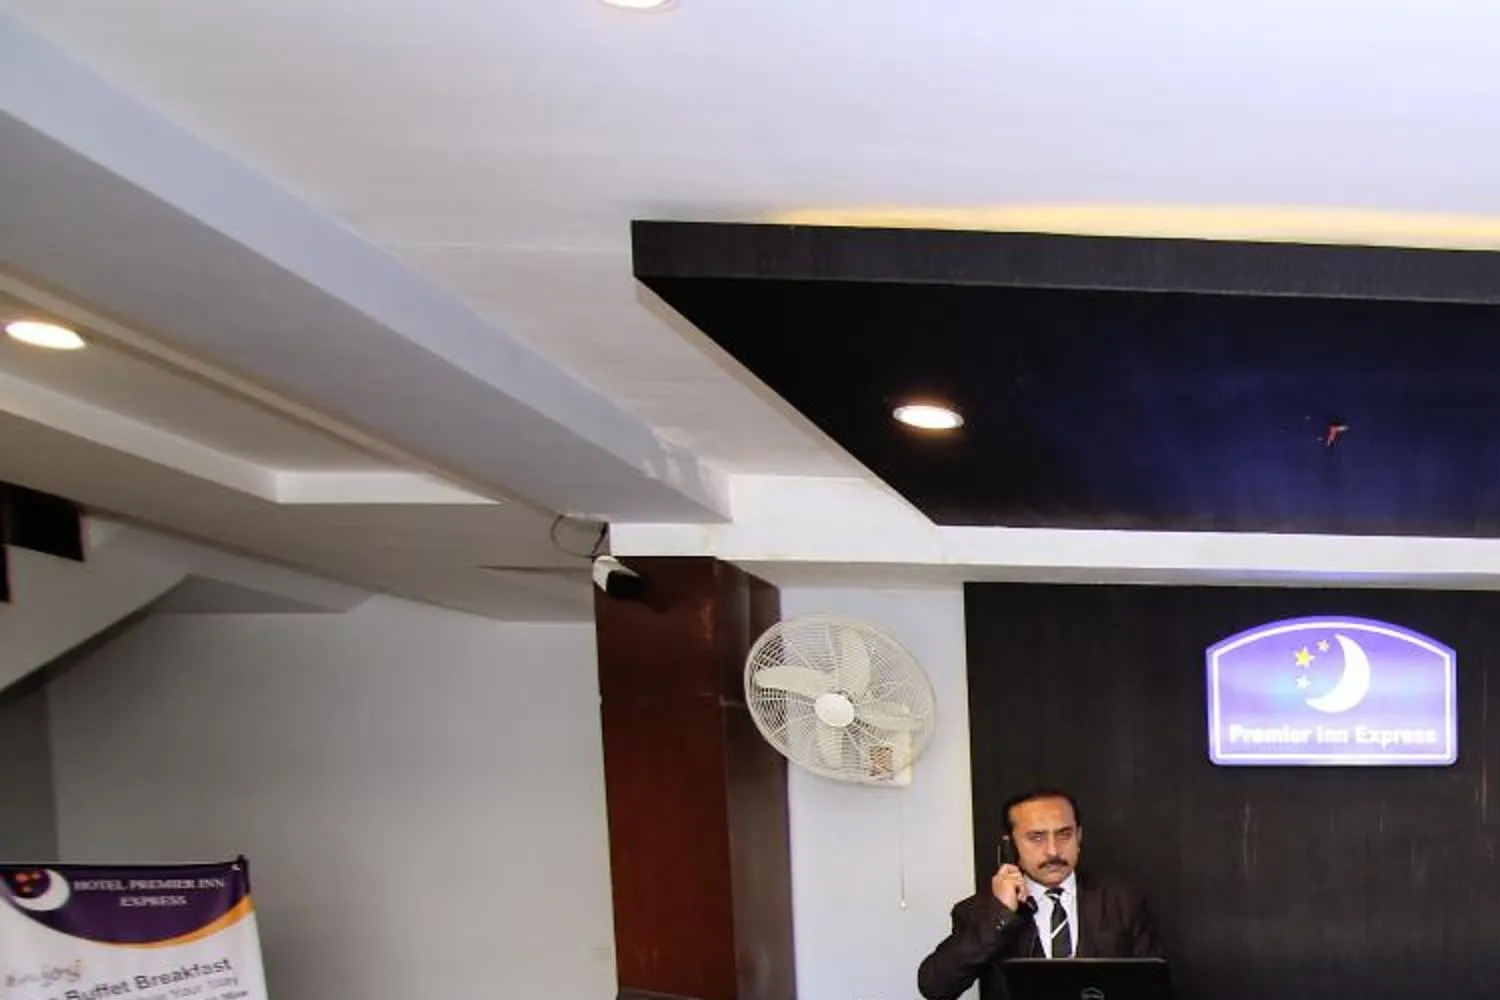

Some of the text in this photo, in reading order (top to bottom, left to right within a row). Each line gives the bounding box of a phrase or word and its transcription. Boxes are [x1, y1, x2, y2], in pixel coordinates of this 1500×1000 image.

[1229, 724, 1437, 750] Premier Inn Express
[74, 878, 225, 891] HOTEL PREMIER INN
[120, 895, 187, 906] EXPRESS
[134, 957, 233, 990] Breakfast
